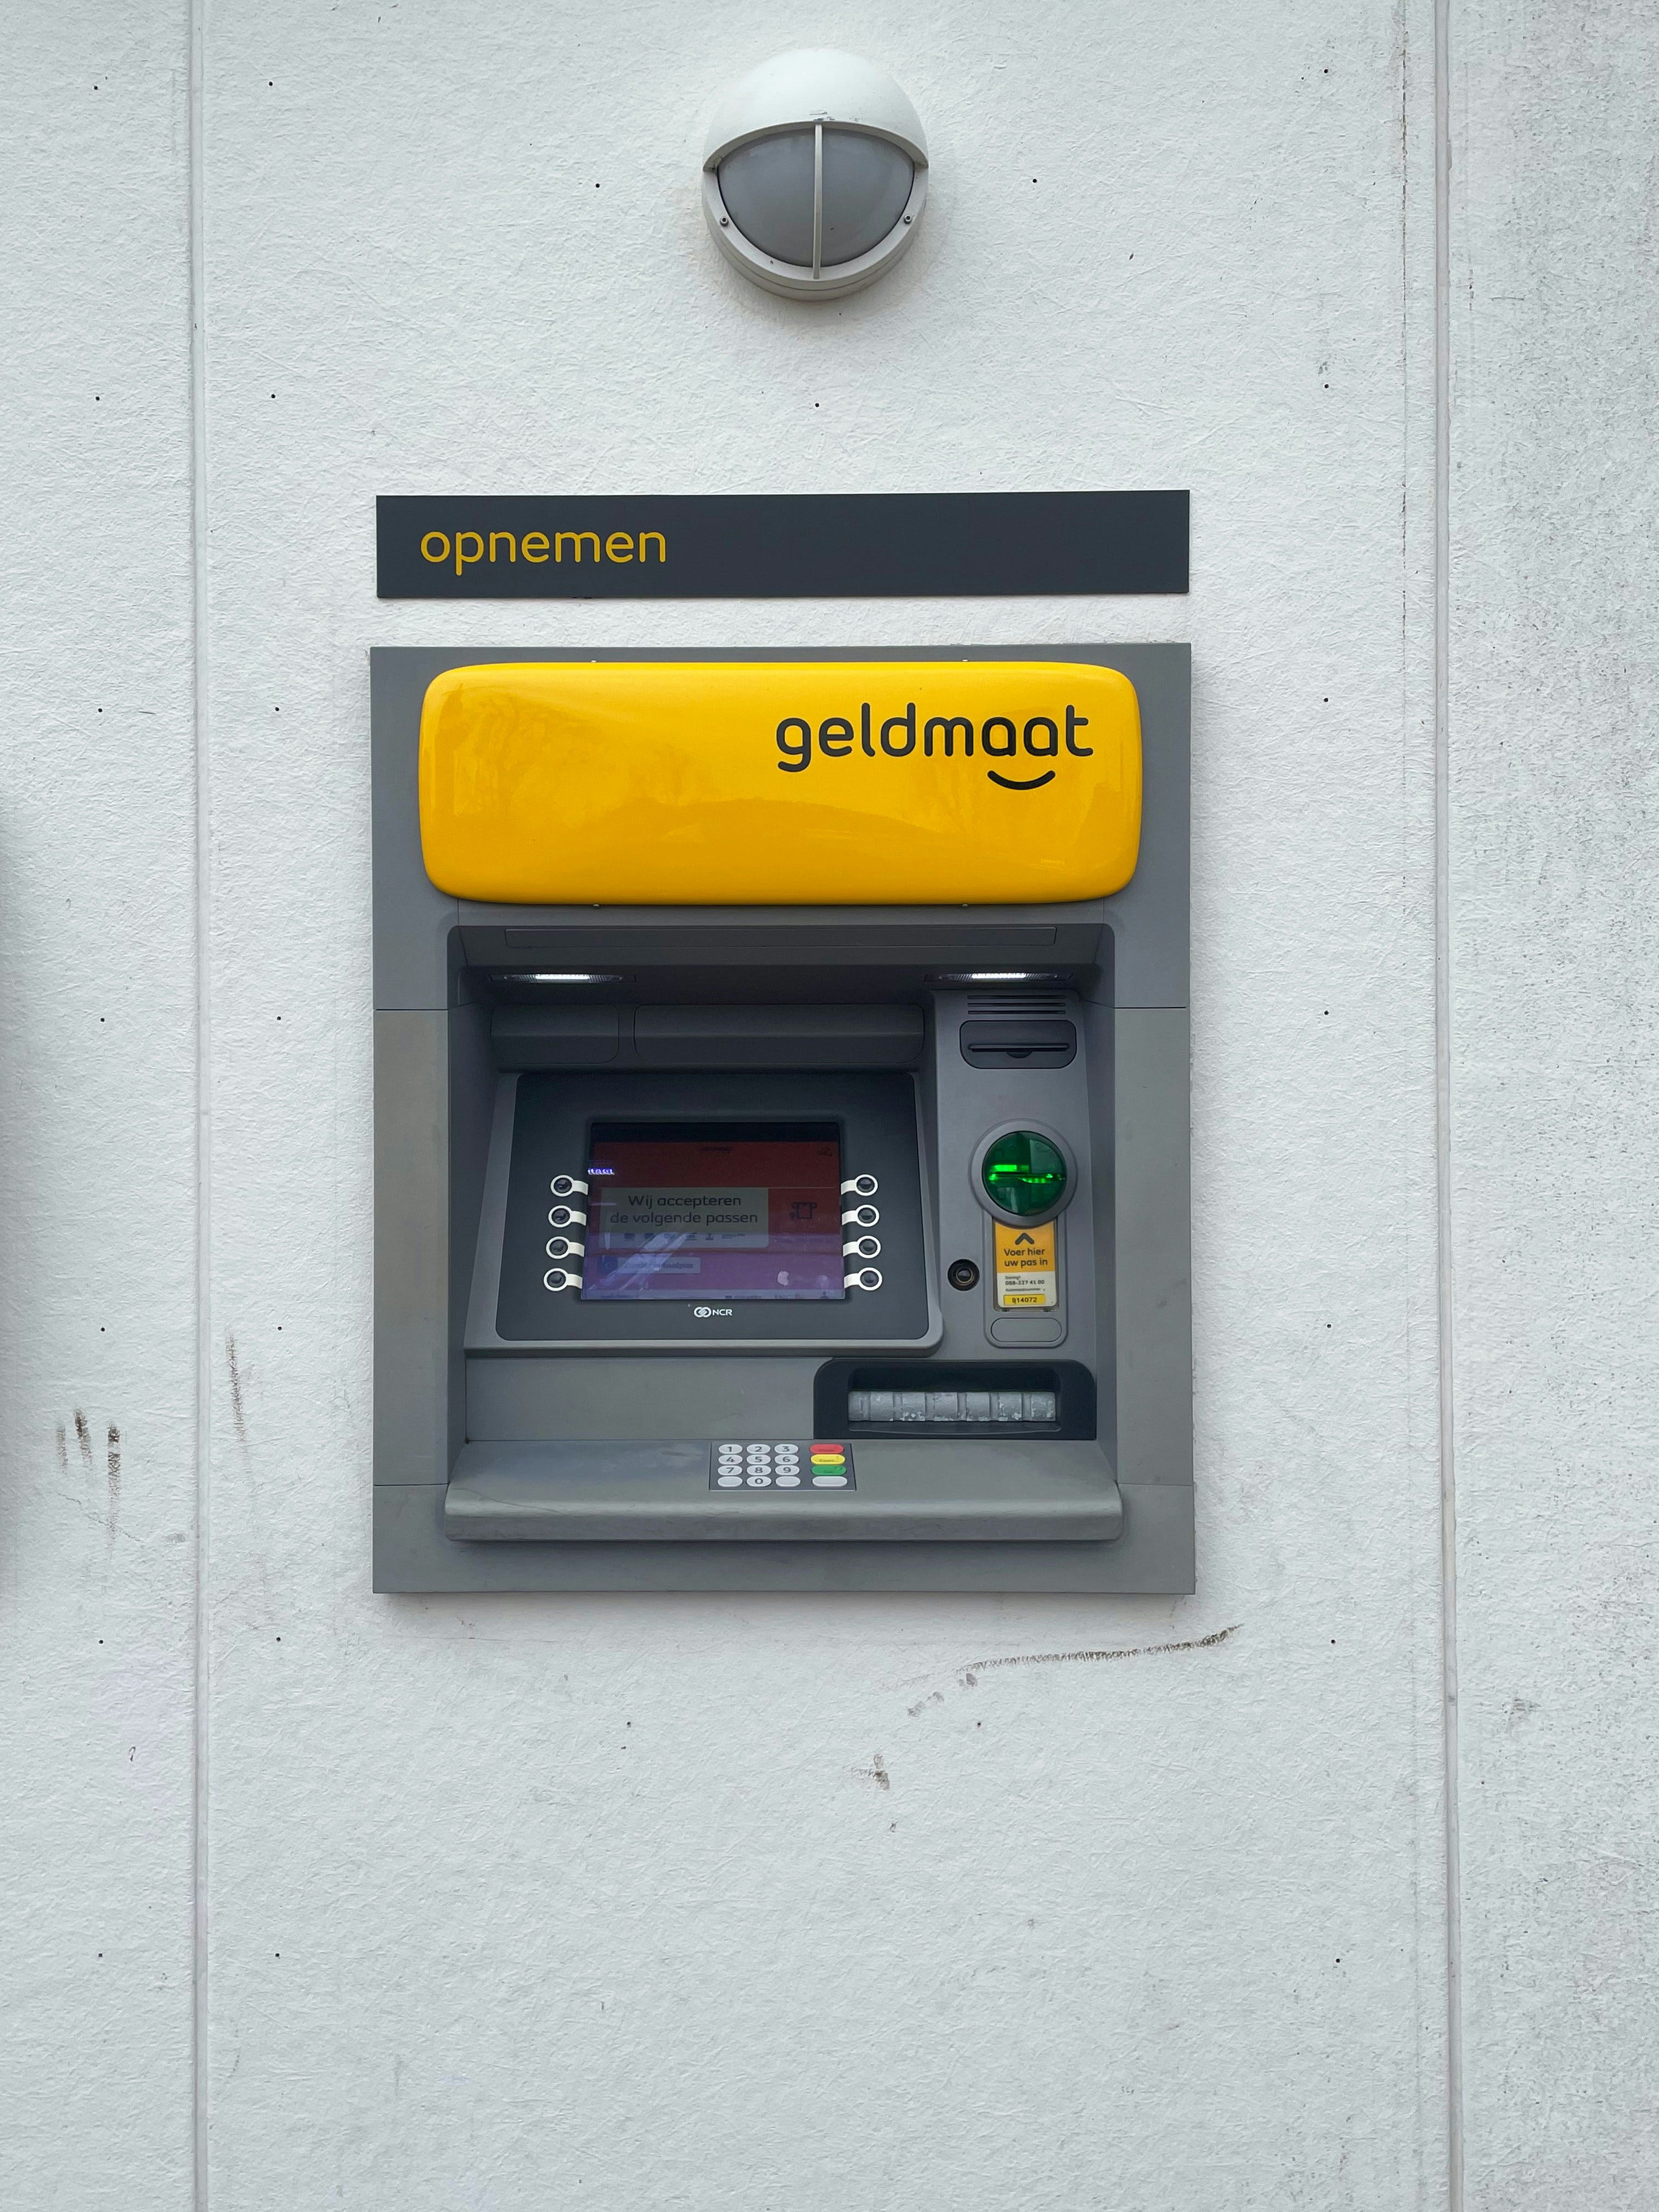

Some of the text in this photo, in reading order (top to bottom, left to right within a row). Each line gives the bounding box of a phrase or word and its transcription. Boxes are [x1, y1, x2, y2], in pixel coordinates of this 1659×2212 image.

[420, 531, 666, 576] opnemen
[776, 702, 1093, 772] geldmaat
[628, 1195, 741, 1209] Wij accepteren
[610, 1212, 758, 1226] de volgende passen
[1004, 1248, 1026, 1256] Voer
[1020, 1260, 1037, 1268] pas
